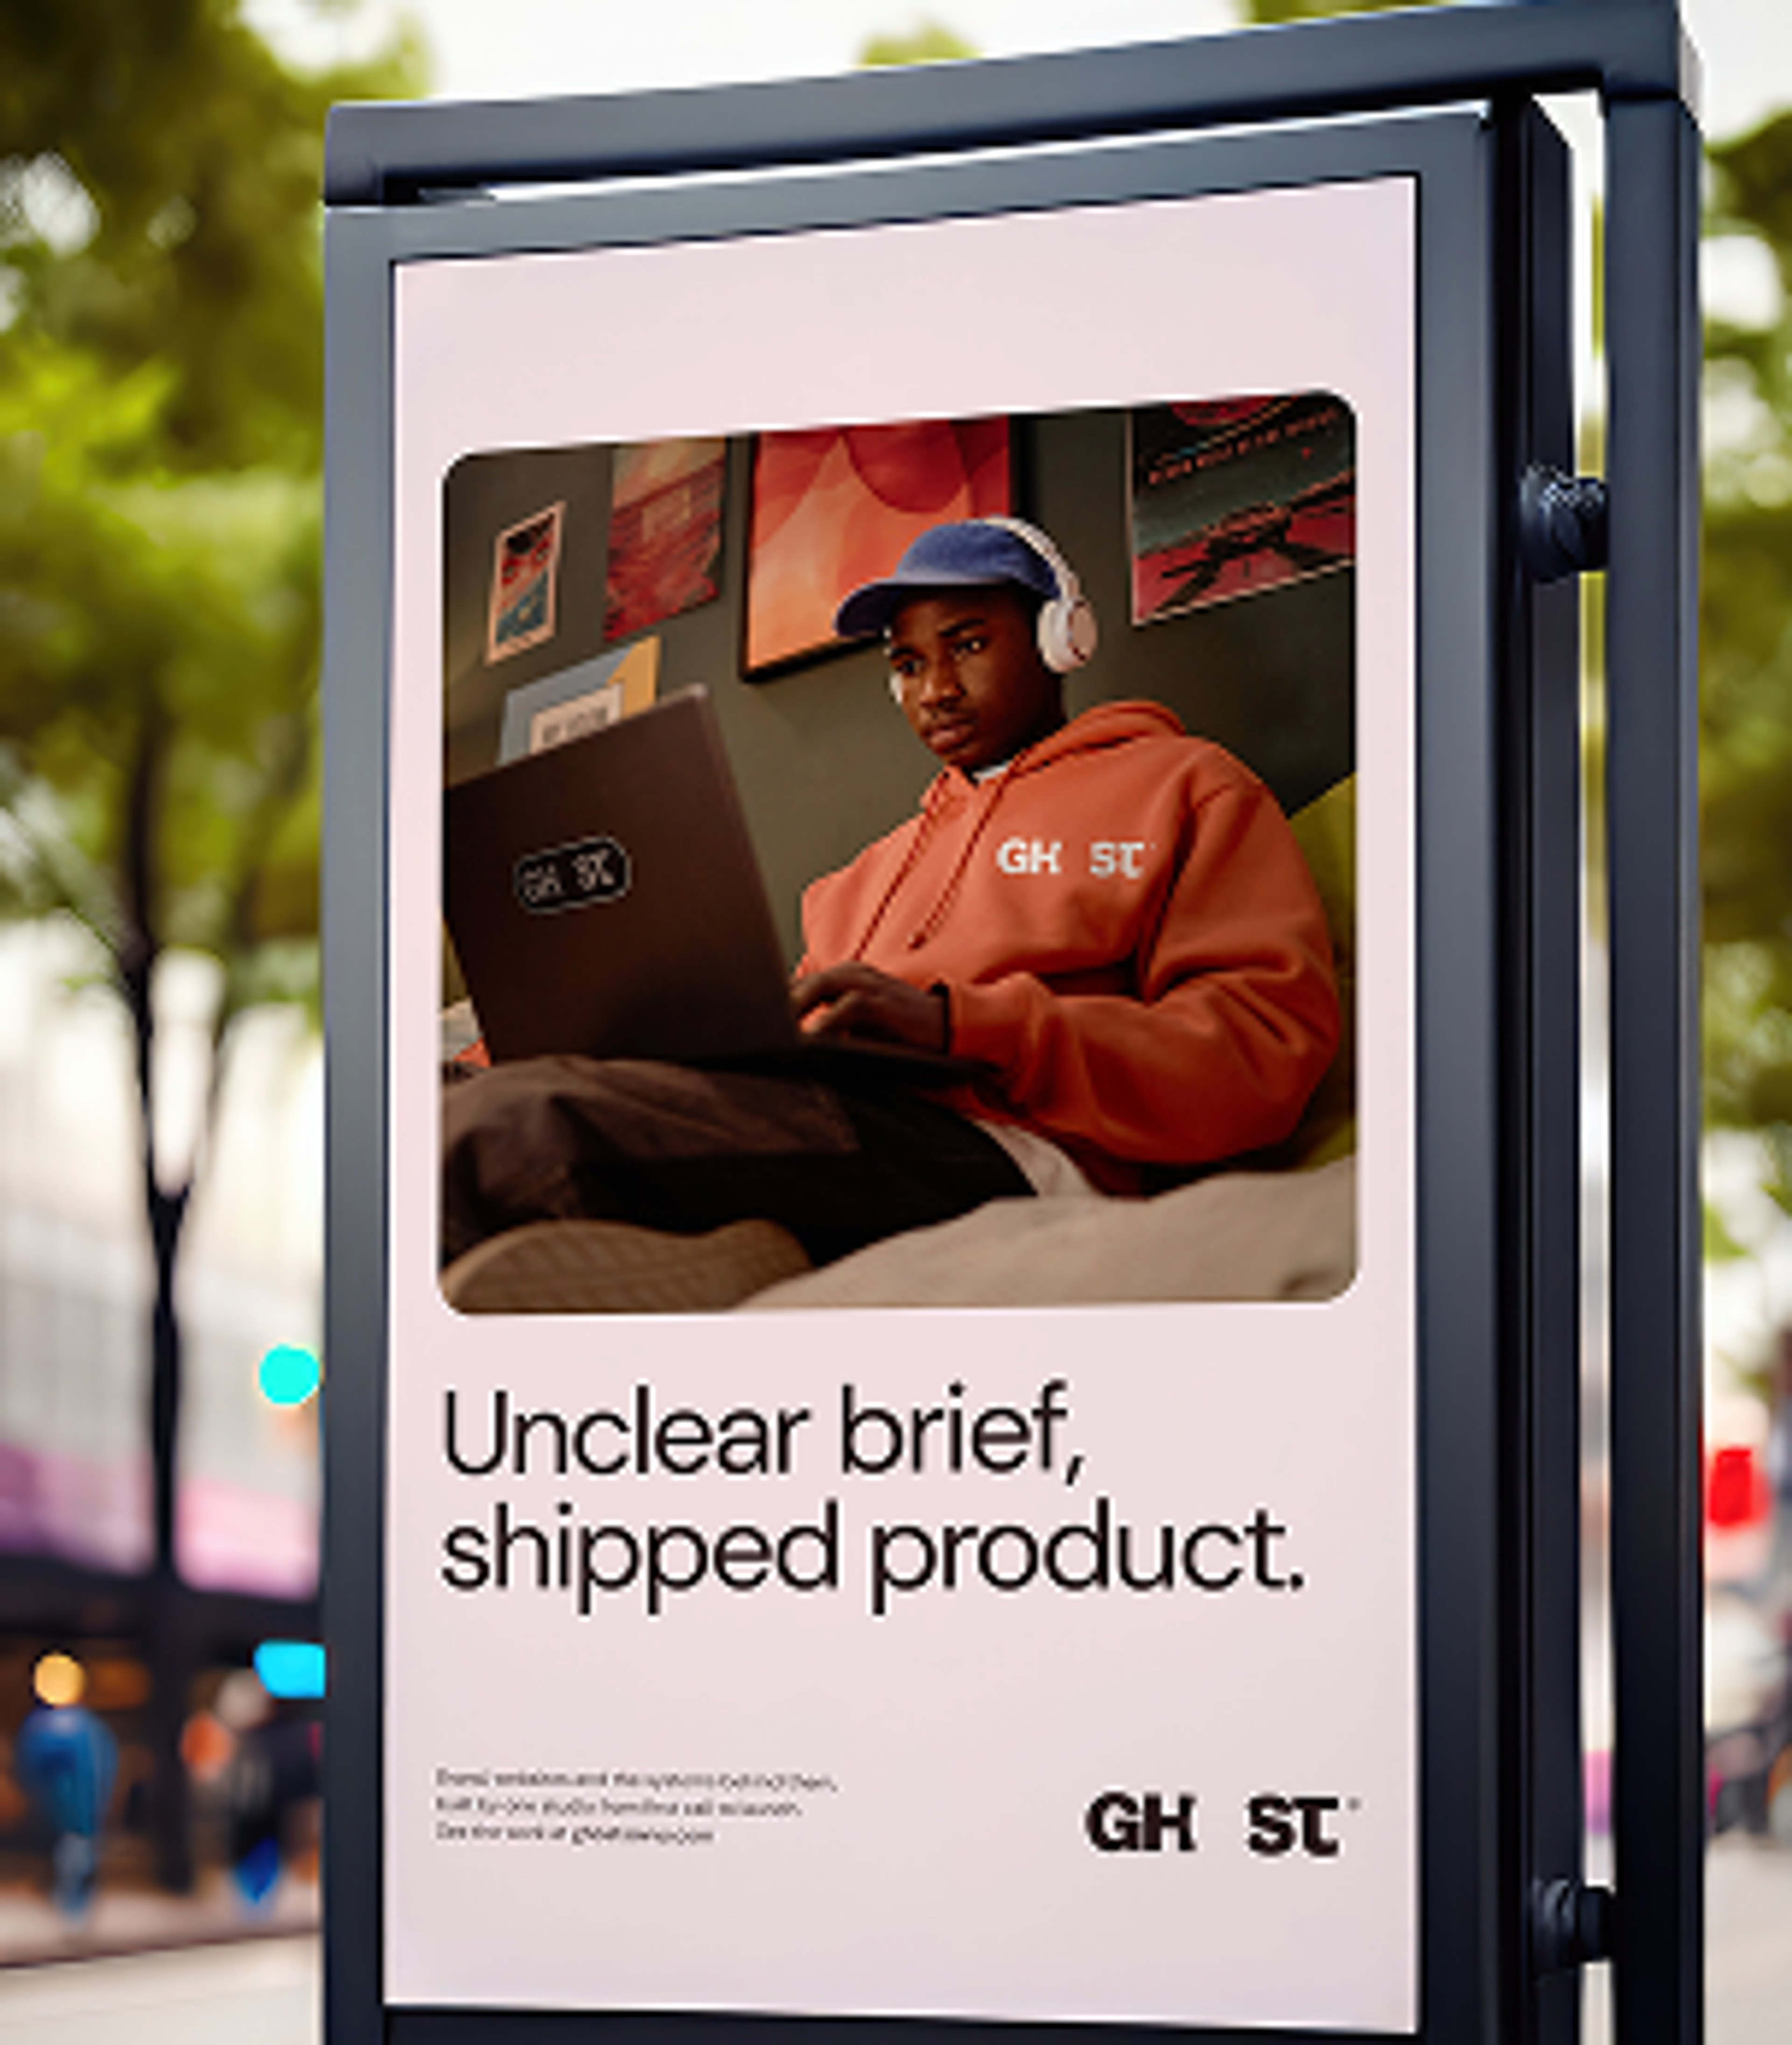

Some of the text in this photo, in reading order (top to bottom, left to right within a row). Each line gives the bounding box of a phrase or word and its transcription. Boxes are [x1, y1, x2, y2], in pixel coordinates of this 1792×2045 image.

[996, 837, 1062, 874] GH
[444, 1379, 1085, 1487] Unclear brief,
[441, 1496, 1305, 1617] shipped product.
[1084, 1791, 1340, 1858] GH ST
